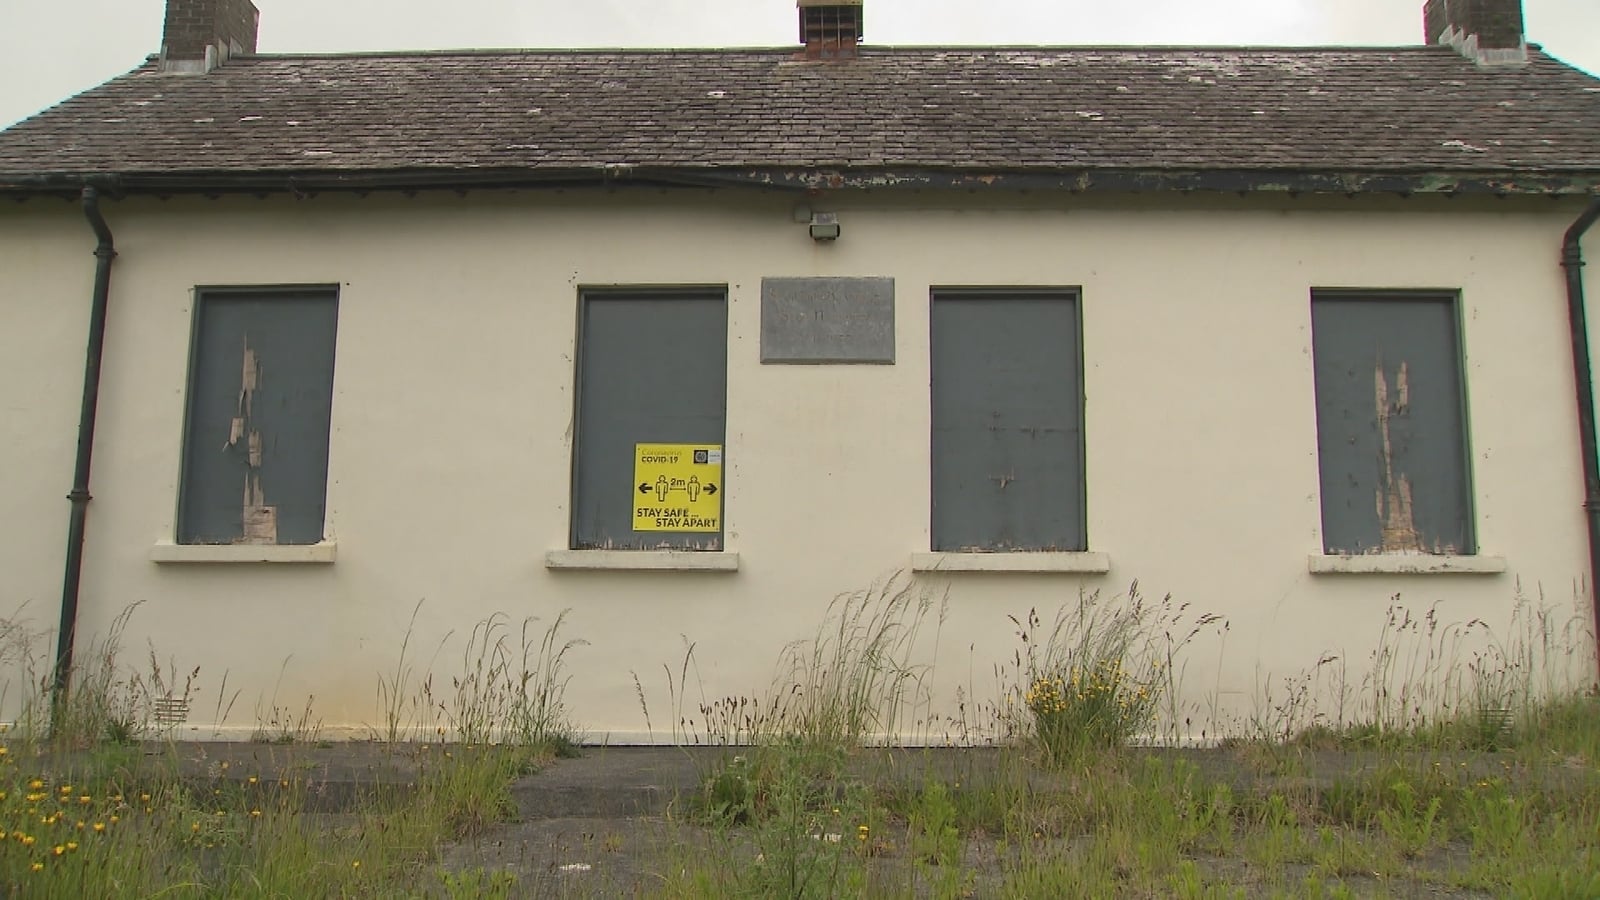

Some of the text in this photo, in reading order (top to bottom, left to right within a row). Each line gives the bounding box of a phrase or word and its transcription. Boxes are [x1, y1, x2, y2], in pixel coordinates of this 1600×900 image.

[670, 478, 685, 486] 2m
[637, 508, 662, 517] STAY
[656, 518, 717, 528] STAY APART
